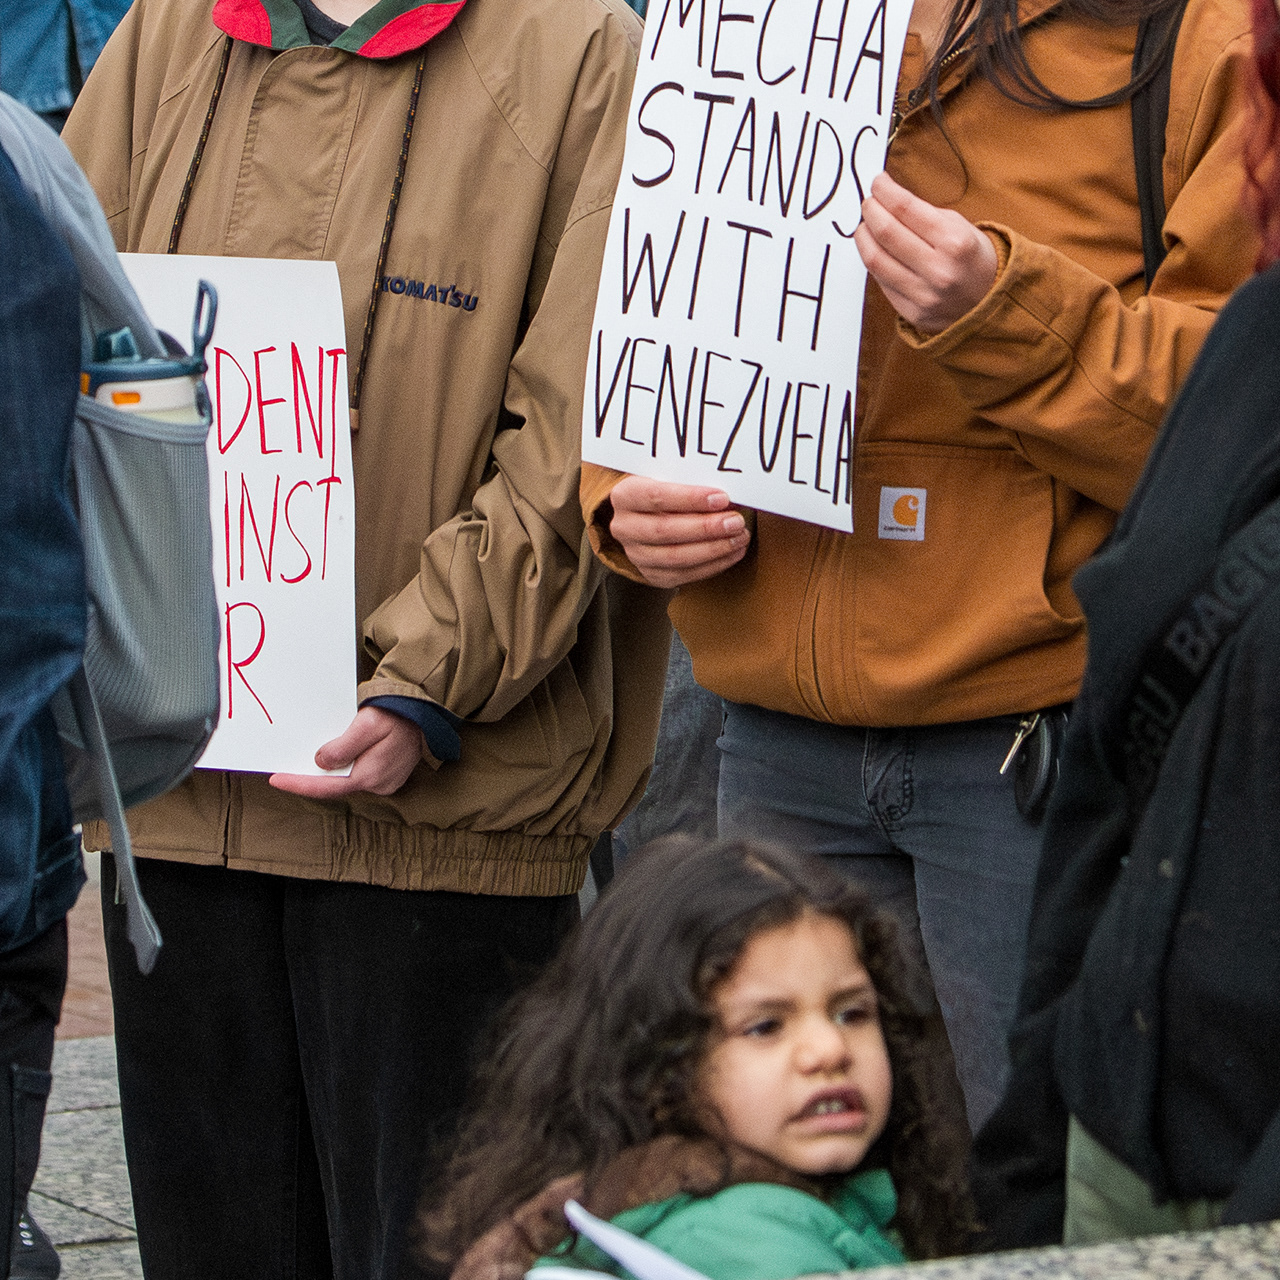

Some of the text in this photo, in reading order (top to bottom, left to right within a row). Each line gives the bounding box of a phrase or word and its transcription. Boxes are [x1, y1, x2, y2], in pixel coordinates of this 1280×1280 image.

[631, 81, 879, 239] STANDS
[621, 207, 831, 352] WITH
[594, 329, 853, 505] VENEZUELA
